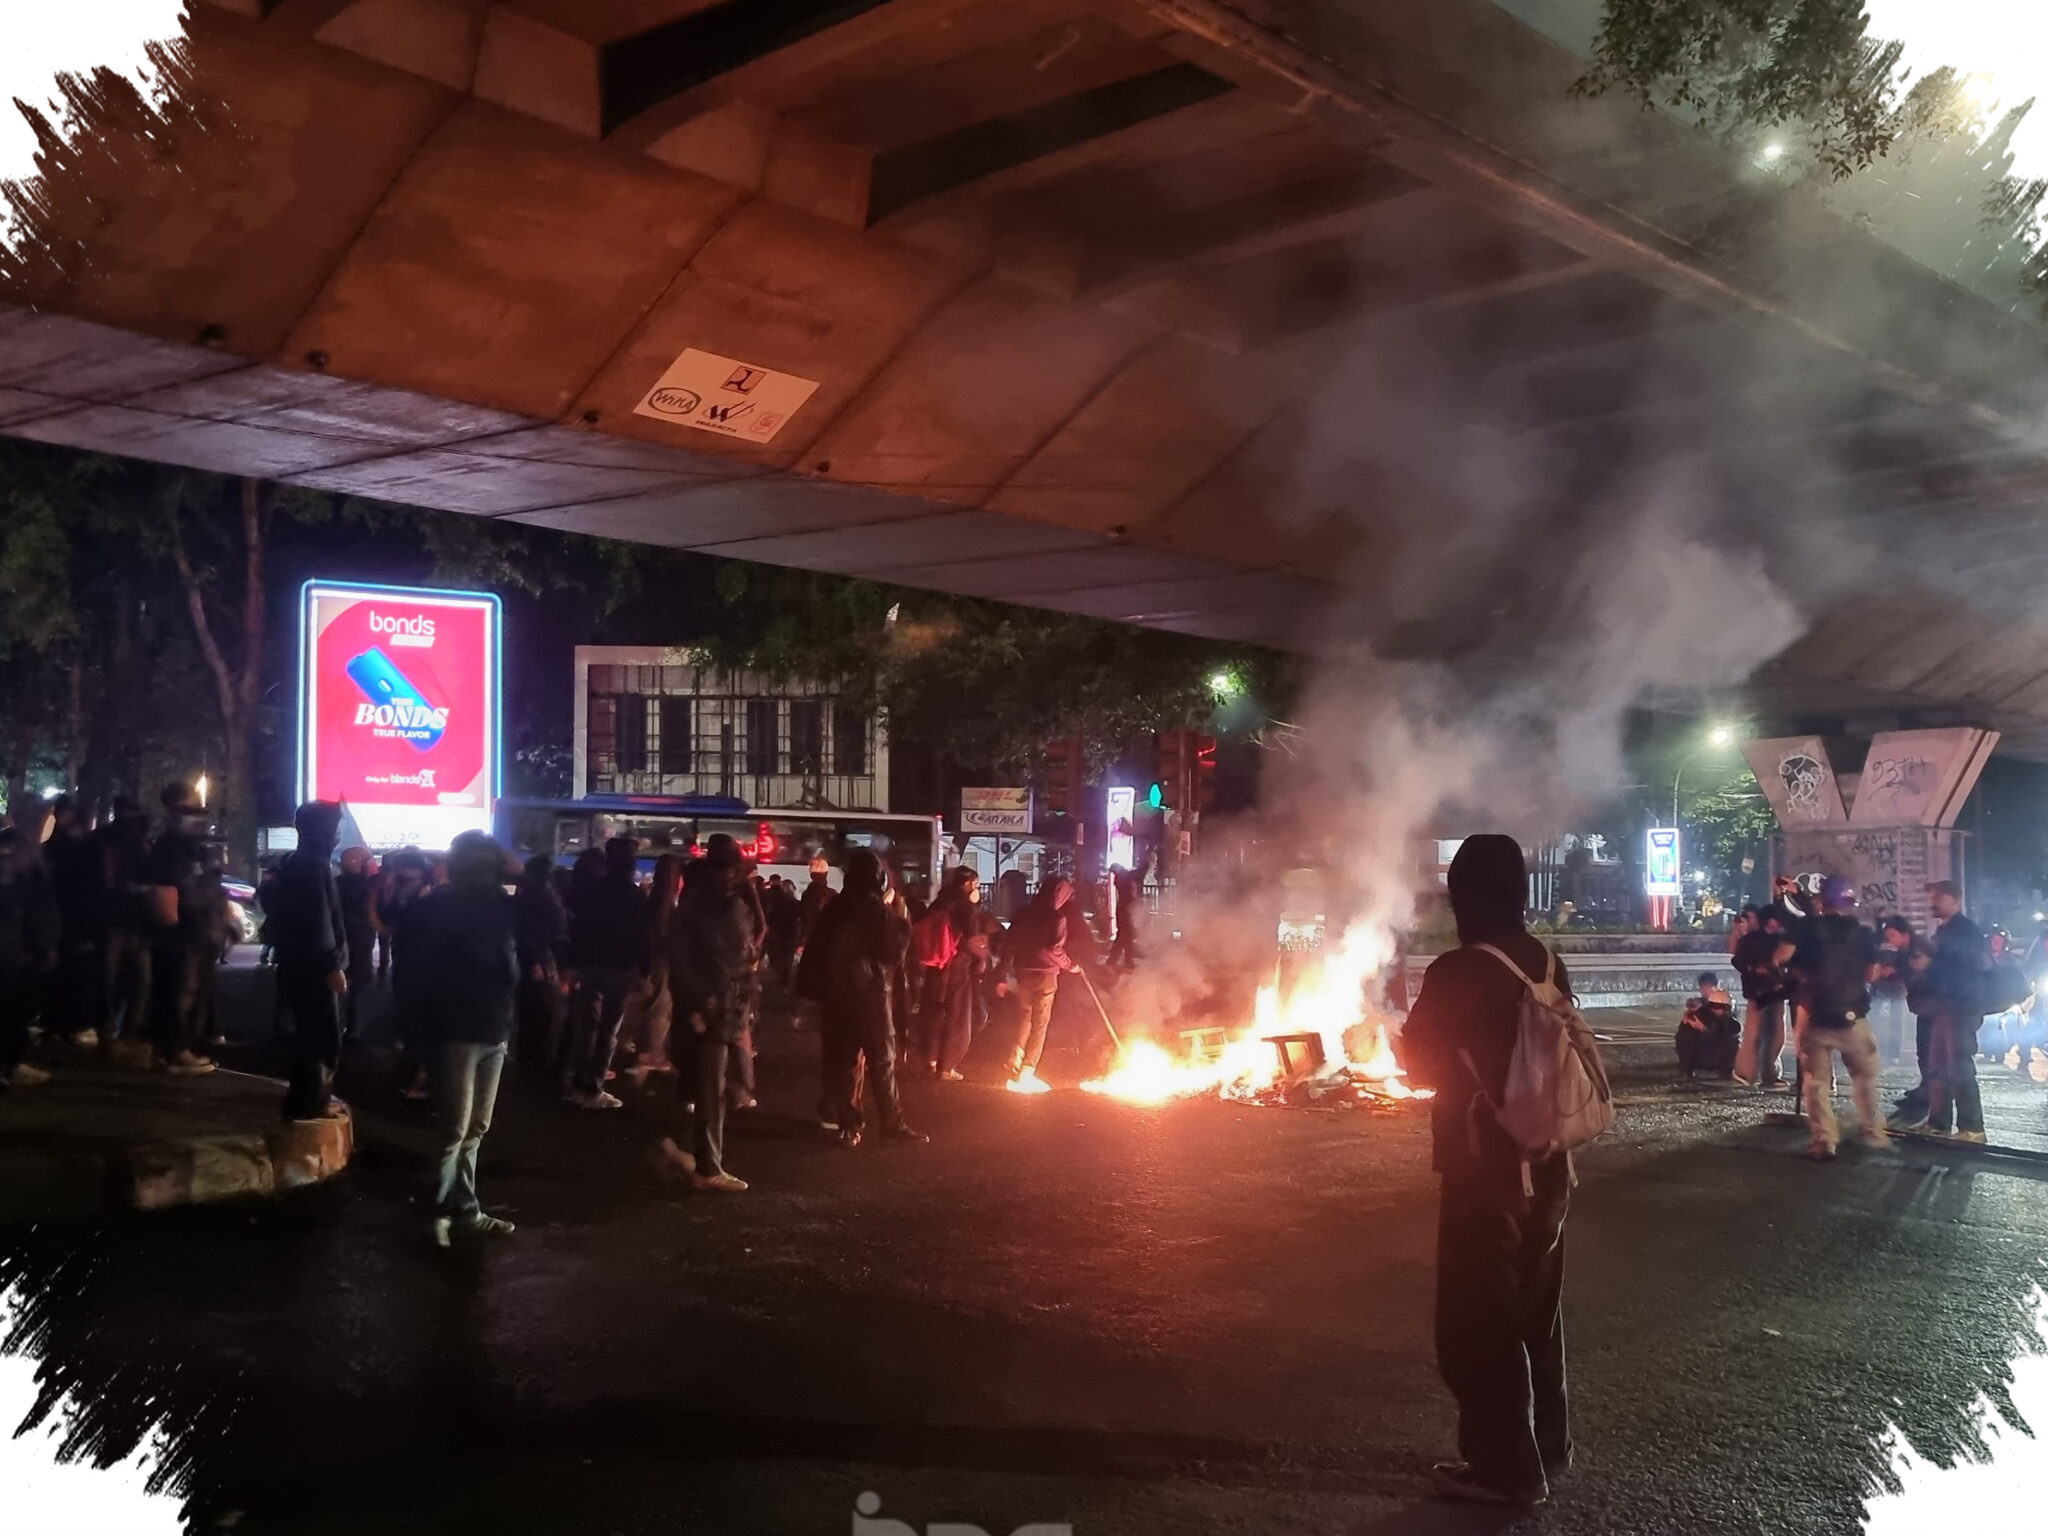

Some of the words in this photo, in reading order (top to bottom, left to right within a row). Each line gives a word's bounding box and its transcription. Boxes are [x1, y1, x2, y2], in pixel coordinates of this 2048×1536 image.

[369, 610, 435, 635] bonds
[355, 703, 449, 728] BONDS
[373, 728, 397, 738] TRUE
[397, 730, 431, 740] FLAVOR
